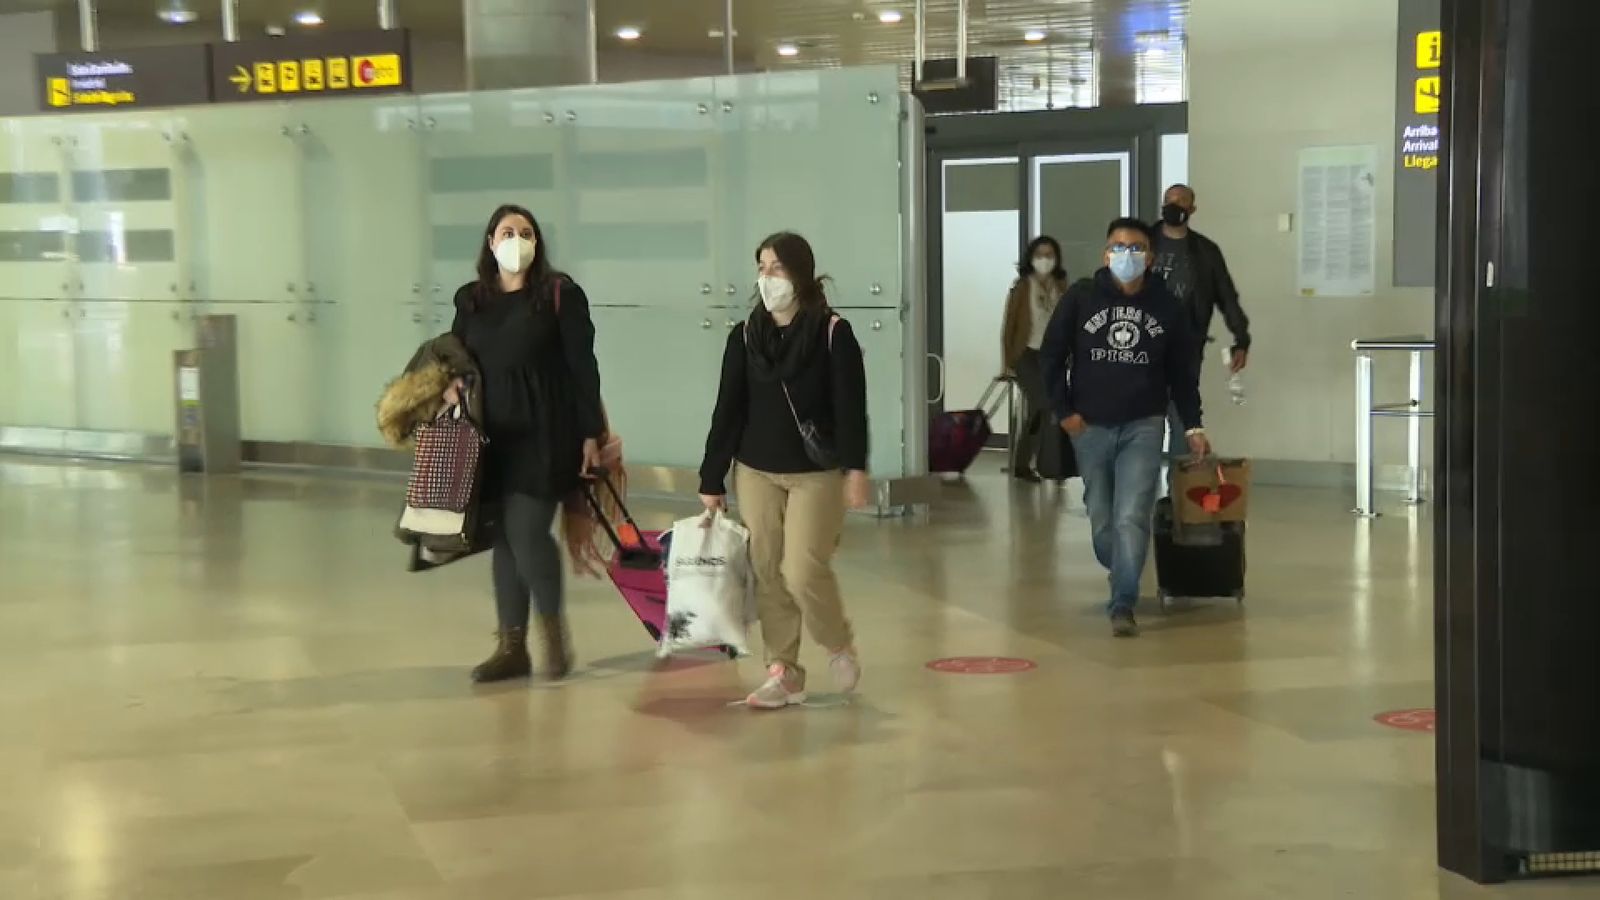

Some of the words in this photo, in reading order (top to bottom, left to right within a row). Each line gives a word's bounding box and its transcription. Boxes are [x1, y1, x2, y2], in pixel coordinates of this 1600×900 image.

[1403, 140, 1439, 152] Arrival
[1404, 154, 1438, 169] Llega
[1090, 348, 1149, 364] PISA
